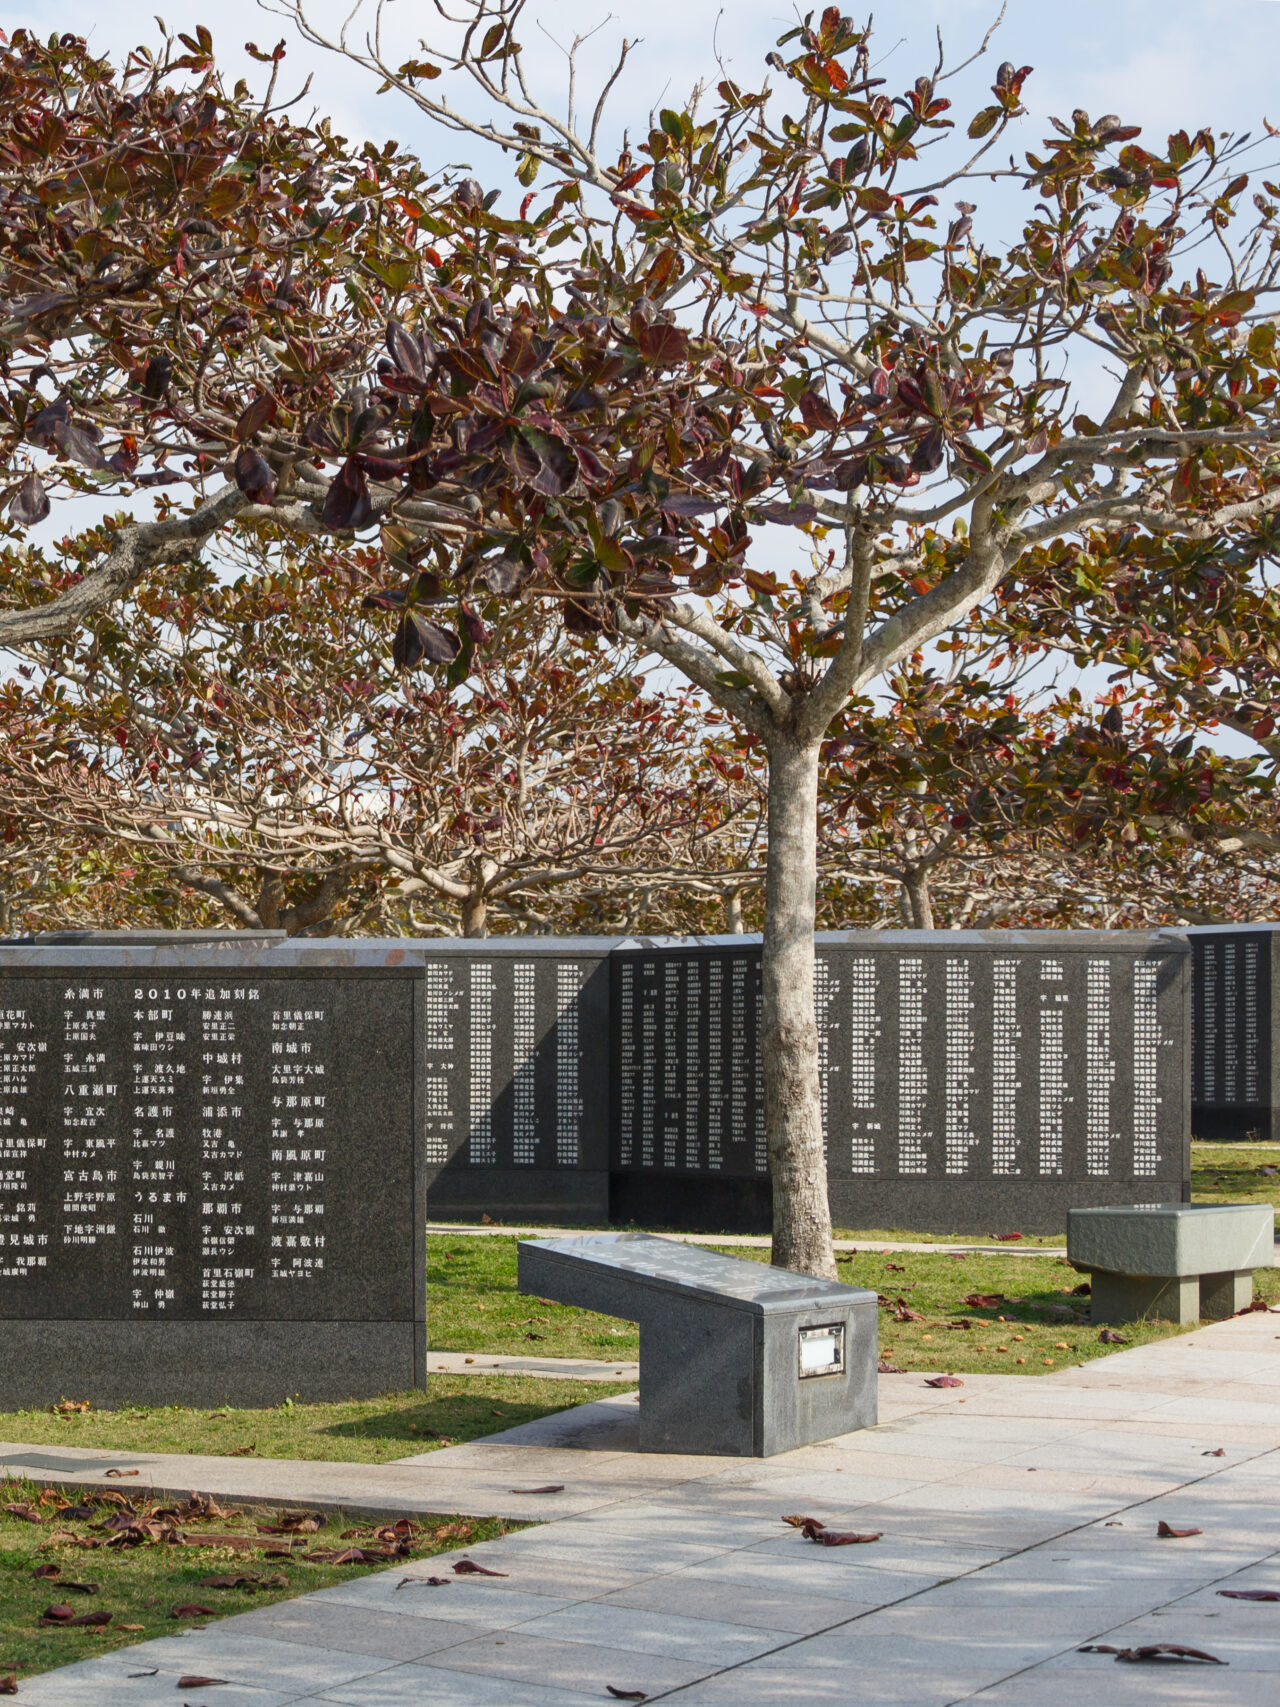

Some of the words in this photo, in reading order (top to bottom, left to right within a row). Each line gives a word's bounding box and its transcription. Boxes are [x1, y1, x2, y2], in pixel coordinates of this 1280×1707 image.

[65, 988, 103, 999] 糸満市
[134, 988, 260, 1000] 2010年追加刻銘
[134, 1010, 173, 1020] 本部町
[203, 1011, 233, 1020] 勝連浜
[274, 1011, 324, 1020] 首里儀保町
[65, 1022, 96, 1030] 上原光子
[134, 1043, 173, 1051] 嘉味田ウシ
[272, 1042, 311, 1053] 南城市
[203, 1053, 242, 1064] 中城村
[272, 1065, 324, 1074] 大里字大城
[134, 1075, 172, 1083] 上運天スミ
[65, 1084, 117, 1095] 八重瀬町
[272, 1096, 325, 1107] 与那原町
[135, 1106, 172, 1117] 名護市
[203, 1106, 242, 1117] 浦添市
[203, 1129, 222, 1138] 牧港
[64, 1150, 95, 1158] 中村カメ
[272, 1150, 325, 1161] 南風原町
[64, 1170, 117, 1181] 宮古島市
[64, 1192, 115, 1201] 上野字野原
[135, 1192, 186, 1202] うるま市
[202, 1203, 241, 1214] 那覇市
[134, 1214, 153, 1223] 石川
[64, 1224, 115, 1234] 下地字洲鎌
[272, 1236, 325, 1247] 渡嘉敷村
[134, 1246, 173, 1255] 石川伊波
[203, 1269, 254, 1278] 首里石嶺町
